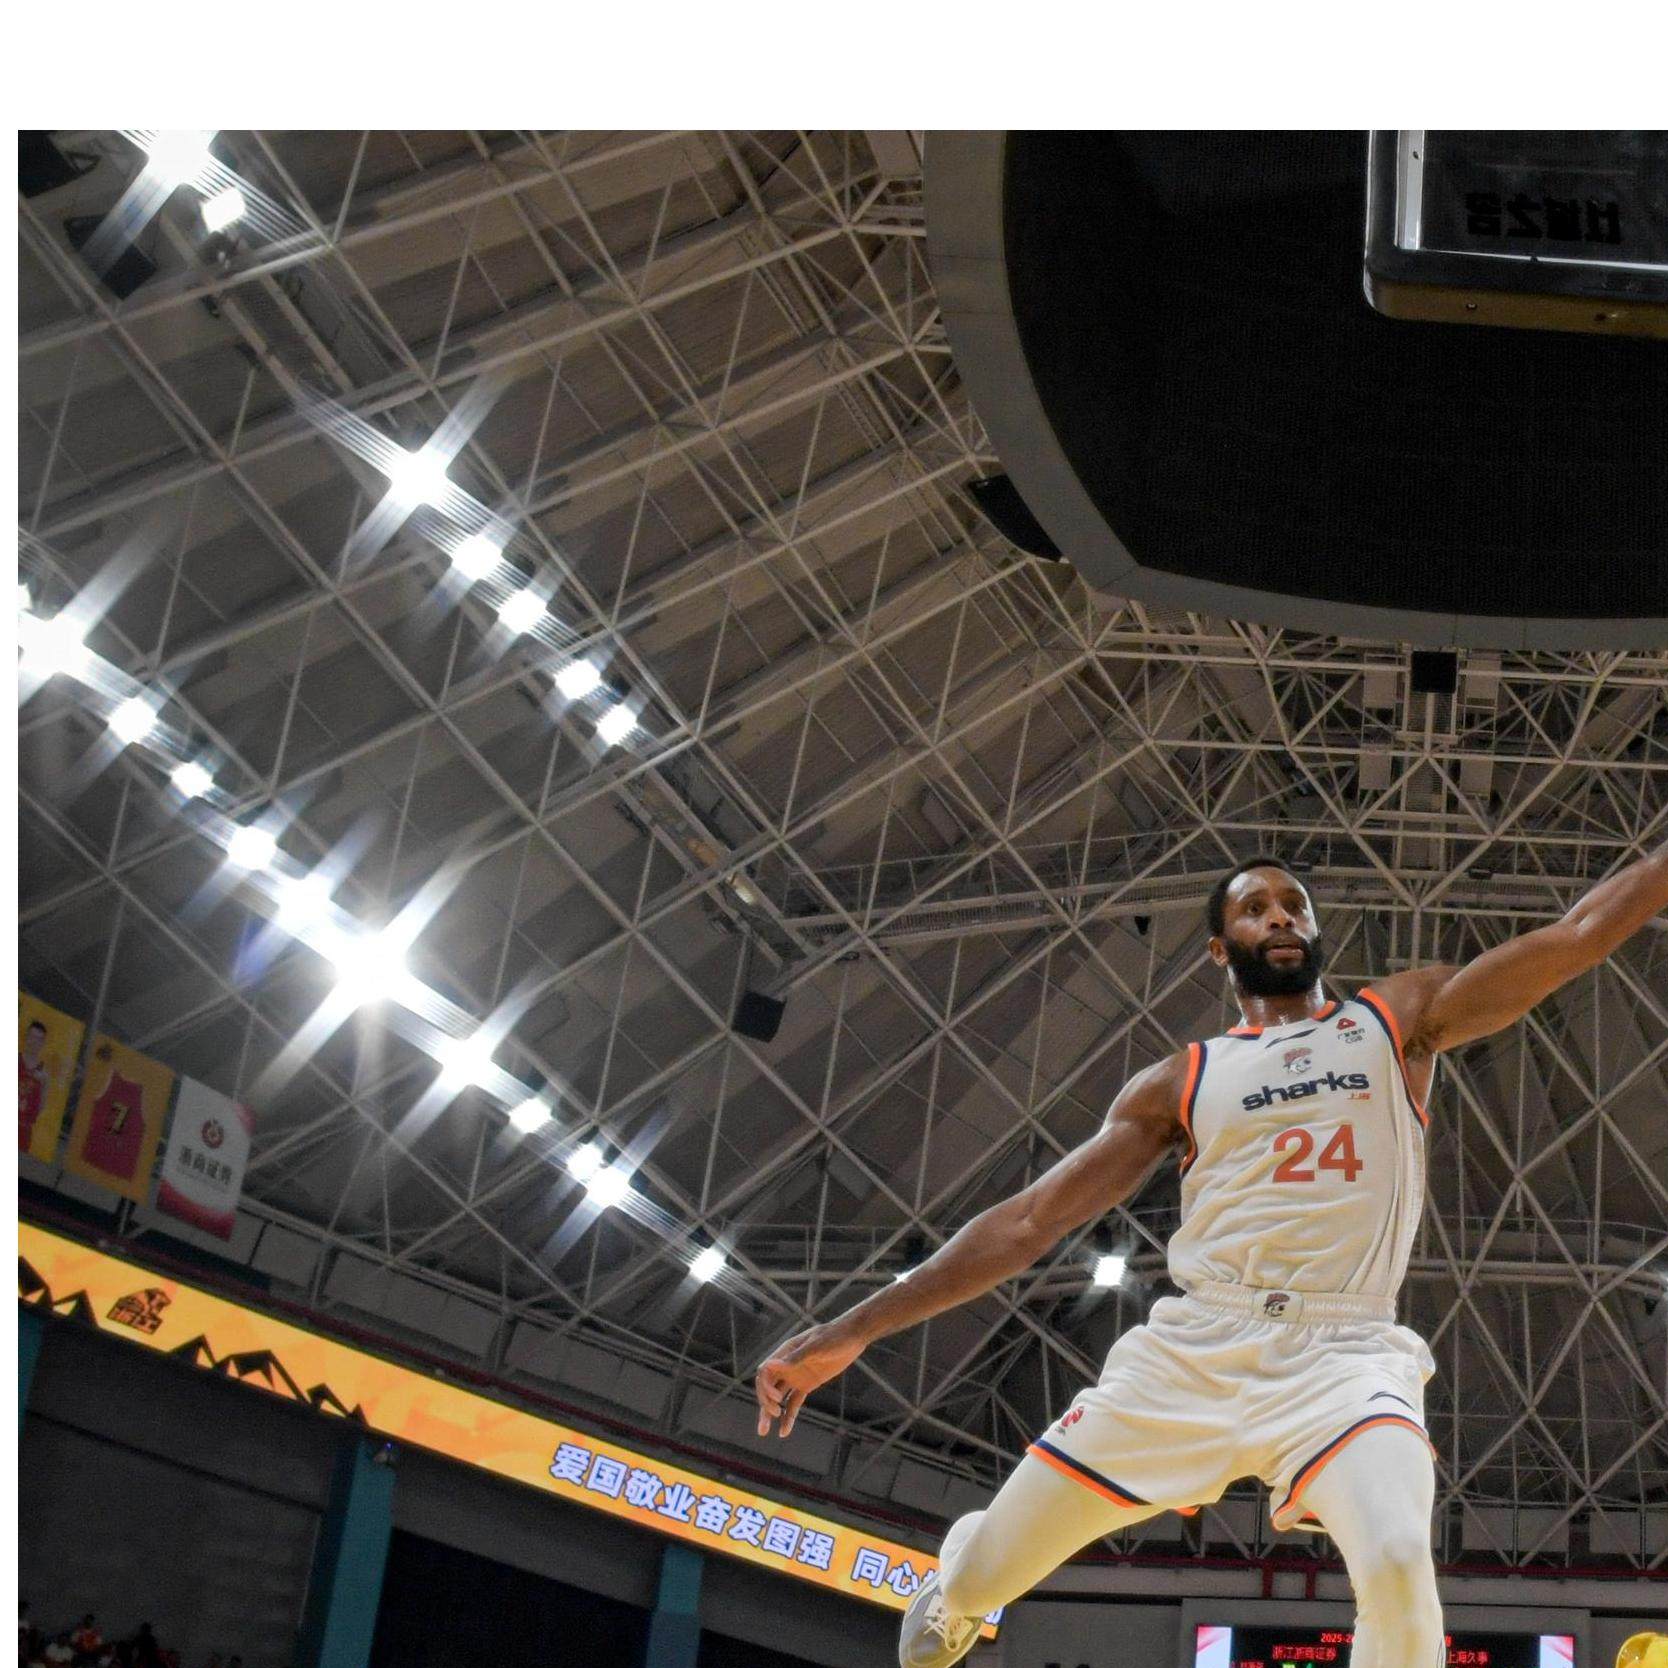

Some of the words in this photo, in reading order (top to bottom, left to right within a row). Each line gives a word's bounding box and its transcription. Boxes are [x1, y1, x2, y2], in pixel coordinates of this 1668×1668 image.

[1242, 1071, 1370, 1111] sharks
[1272, 1124, 1363, 1183] 24
[549, 1442, 836, 1570] 爱国敬业奋发图强
[852, 1547, 940, 1599] 同心
